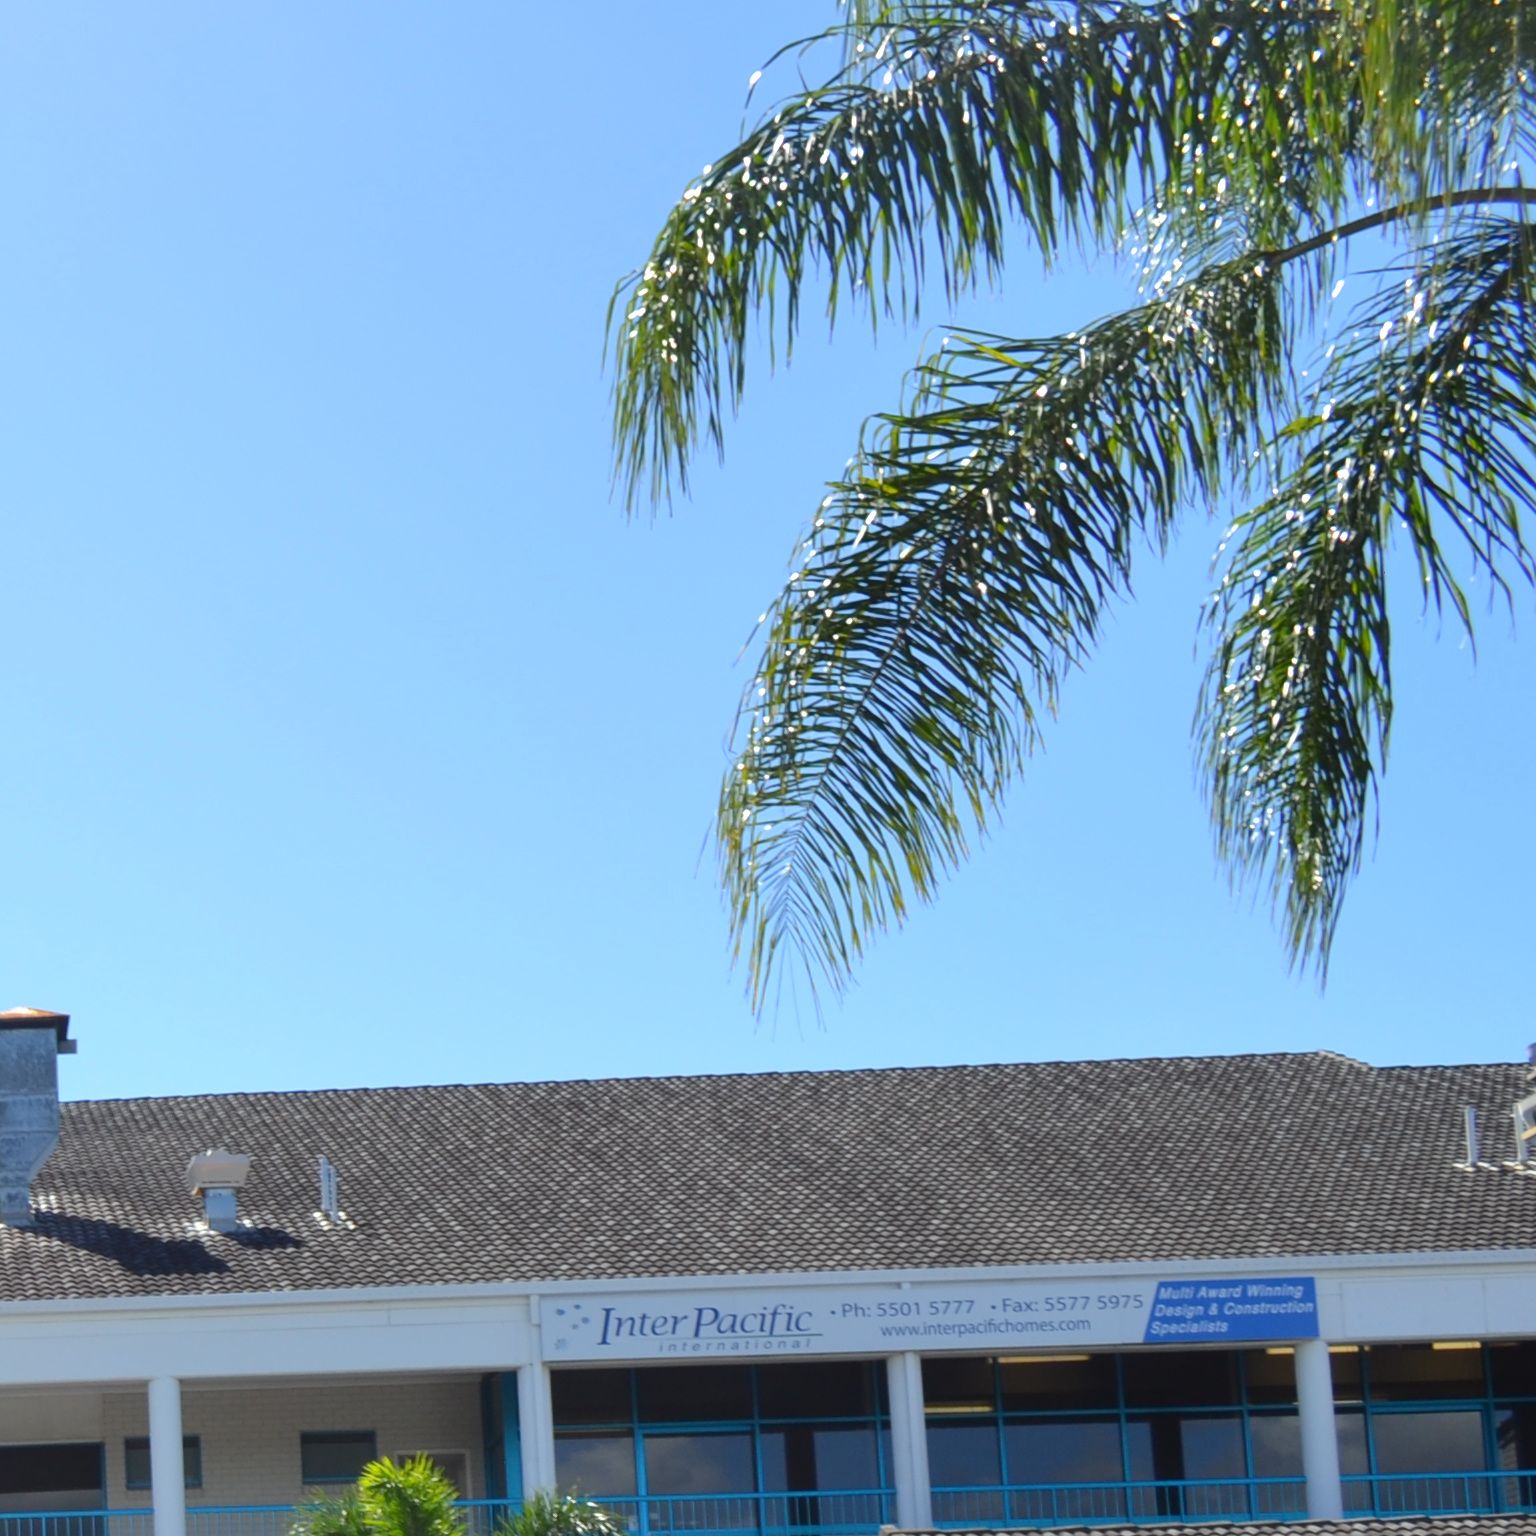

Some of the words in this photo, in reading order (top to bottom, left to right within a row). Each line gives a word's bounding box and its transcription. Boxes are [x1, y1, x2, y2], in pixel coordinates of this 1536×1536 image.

[1159, 1287, 1195, 1299] Multi
[1197, 1285, 1243, 1298] Award
[1247, 1284, 1305, 1298] Winning
[842, 1303, 871, 1318] Ph:
[877, 1302, 922, 1317] 5501
[929, 1300, 975, 1316] 5777
[1002, 1298, 1039, 1313] Fax:
[1044, 1296, 1090, 1312] 5577
[1097, 1294, 1144, 1310] 5975
[1155, 1304, 1204, 1319] Design
[1223, 1301, 1314, 1316] Construction
[881, 1318, 1092, 1338] www.interpacifichomes.com
[1150, 1320, 1229, 1337] Specialists
[658, 1336, 812, 1353] international
